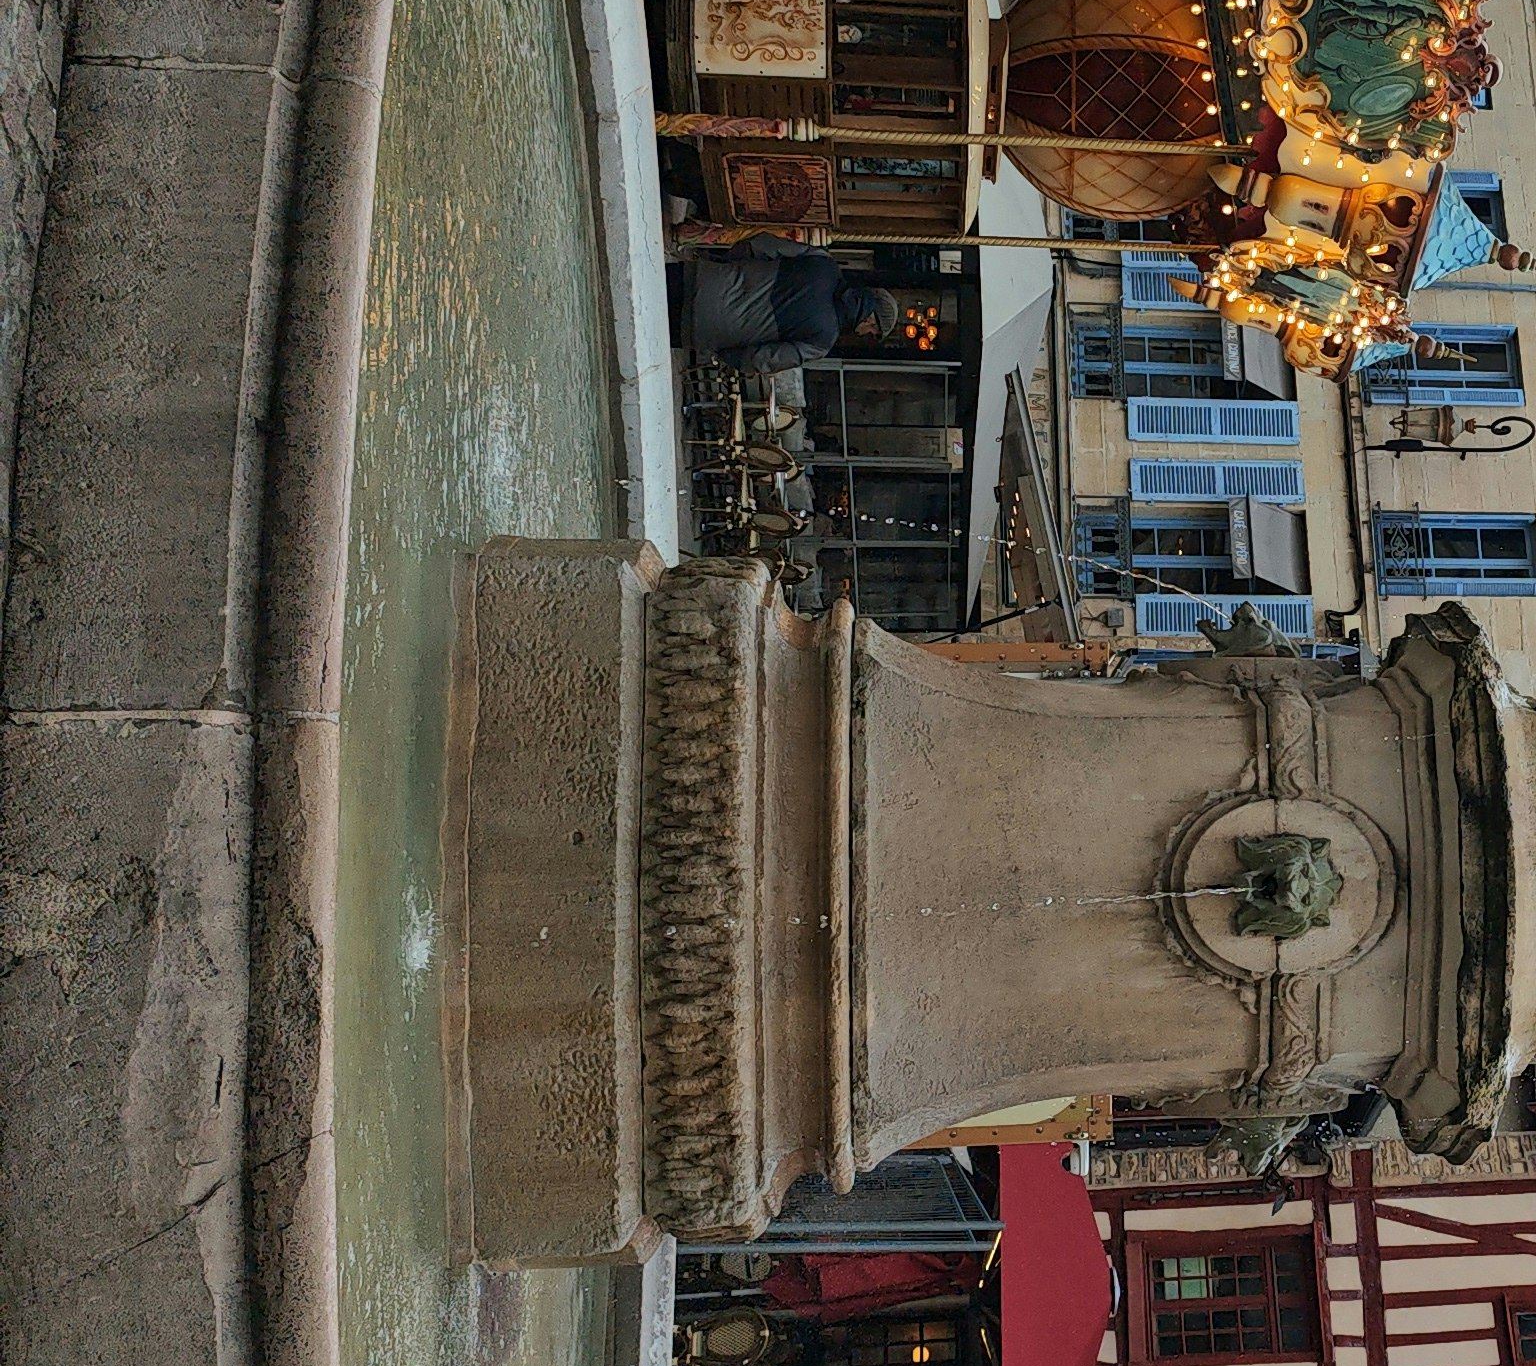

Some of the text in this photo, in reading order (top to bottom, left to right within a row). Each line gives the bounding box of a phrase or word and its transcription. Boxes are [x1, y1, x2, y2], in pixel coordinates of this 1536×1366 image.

[1226, 321, 1240, 373] VICE CONTINU
[1233, 510, 1247, 529] CAFÉ
[1235, 541, 1249, 565] APÉRO
